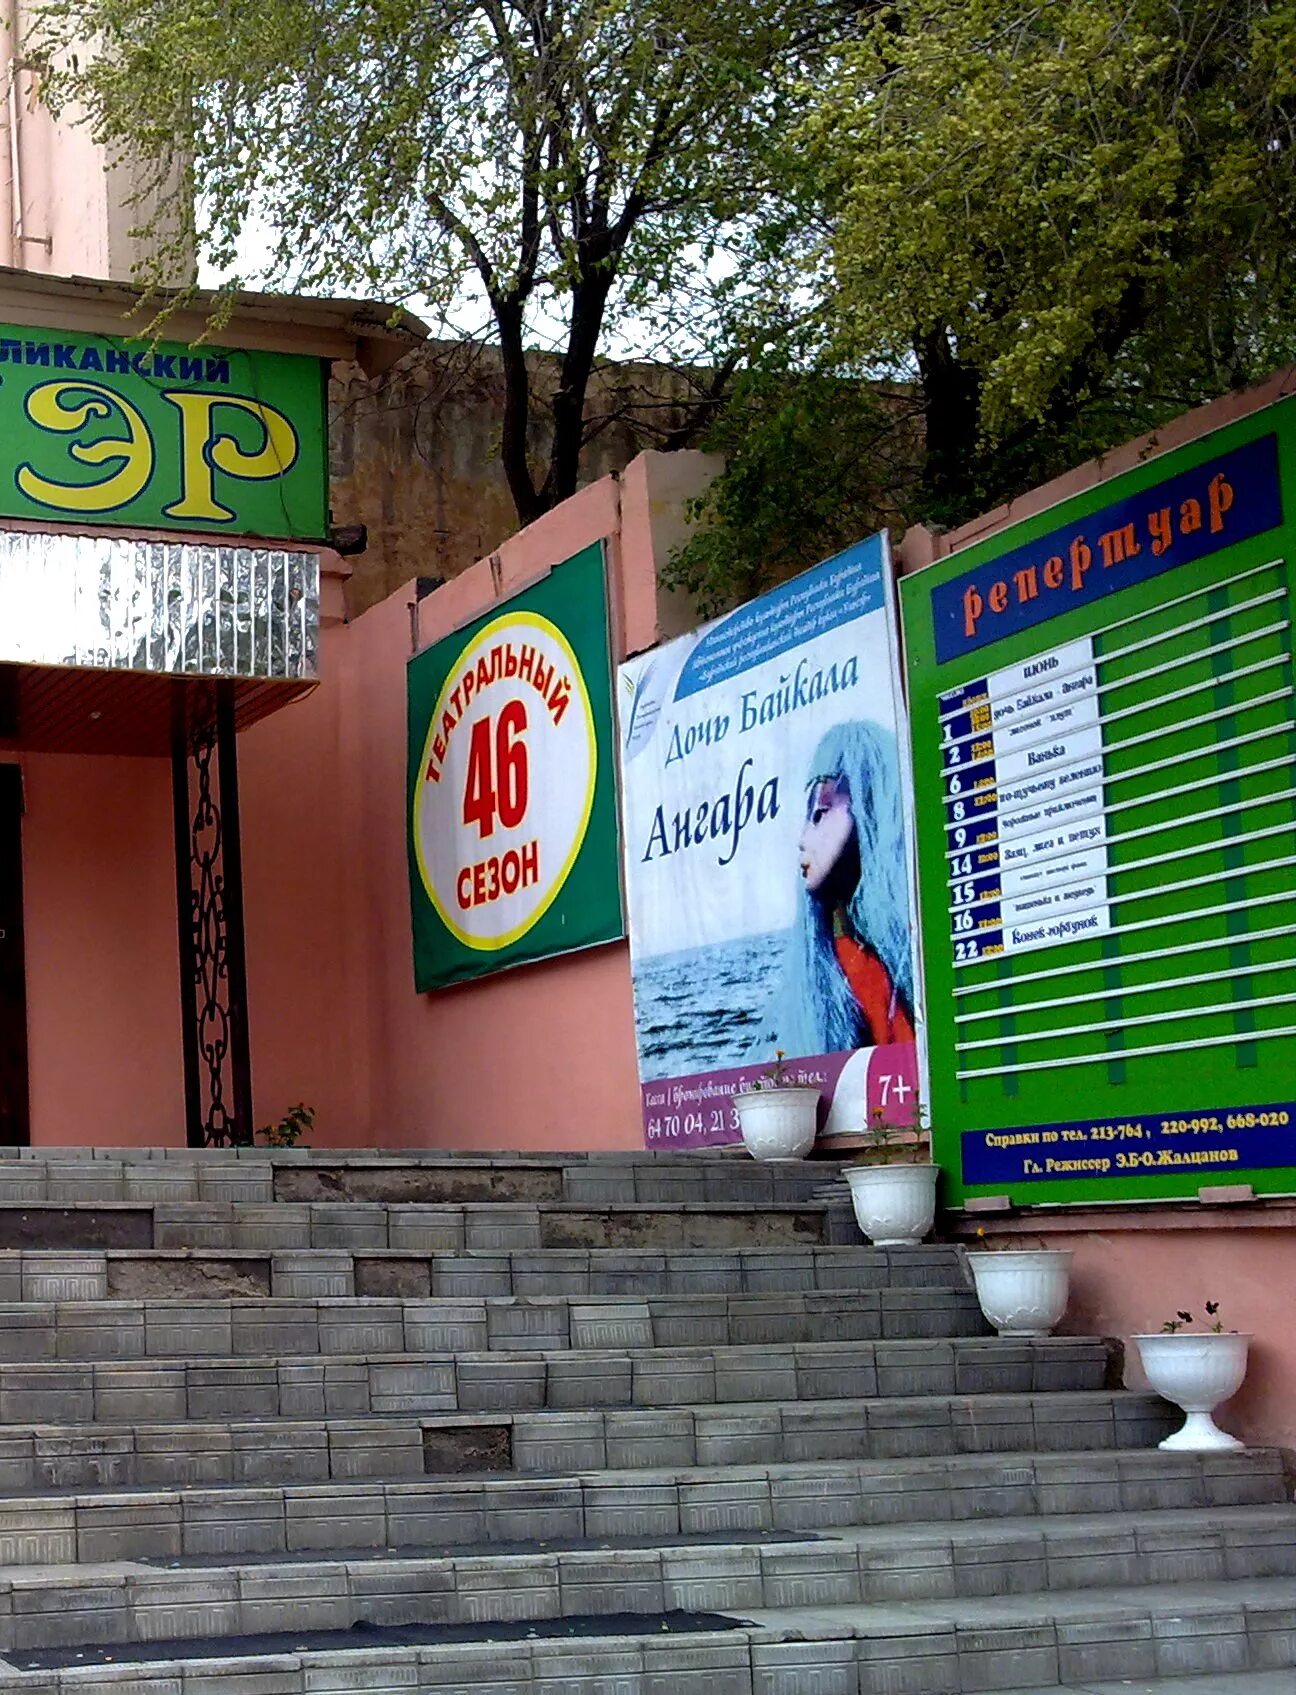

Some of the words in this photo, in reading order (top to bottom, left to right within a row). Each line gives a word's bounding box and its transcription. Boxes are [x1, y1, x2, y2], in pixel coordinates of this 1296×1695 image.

[962, 472, 1235, 638] репертуар
[425, 643, 571, 784] ТЕАТРАЛЬНЫЙ
[665, 715, 730, 769] Дочь
[739, 656, 859, 733] Байкала
[943, 724, 953, 742] 1
[949, 747, 961, 765] 2
[462, 698, 529, 840] 46
[949, 774, 961, 794] 6
[641, 758, 782, 866] Ангара
[953, 801, 965, 820] 8
[955, 828, 966, 848] 9
[456, 840, 539, 911] СЕЗОН
[951, 854, 972, 876] 14
[953, 881, 975, 904] 15
[953, 910, 974, 931] 16
[955, 940, 978, 960] 22
[878, 1074, 912, 1106] 7+
[664, 1116, 680, 1136] 70
[710, 1110, 725, 1131] 21
[729, 1108, 741, 1130] 3
[985, 1133, 1040, 1149] Справки
[1042, 1131, 1058, 1143] по
[1061, 1129, 1087, 1141] тел.
[1023, 1159, 1043, 1174] Гл.
[1046, 1157, 1111, 1173] Режиссер
